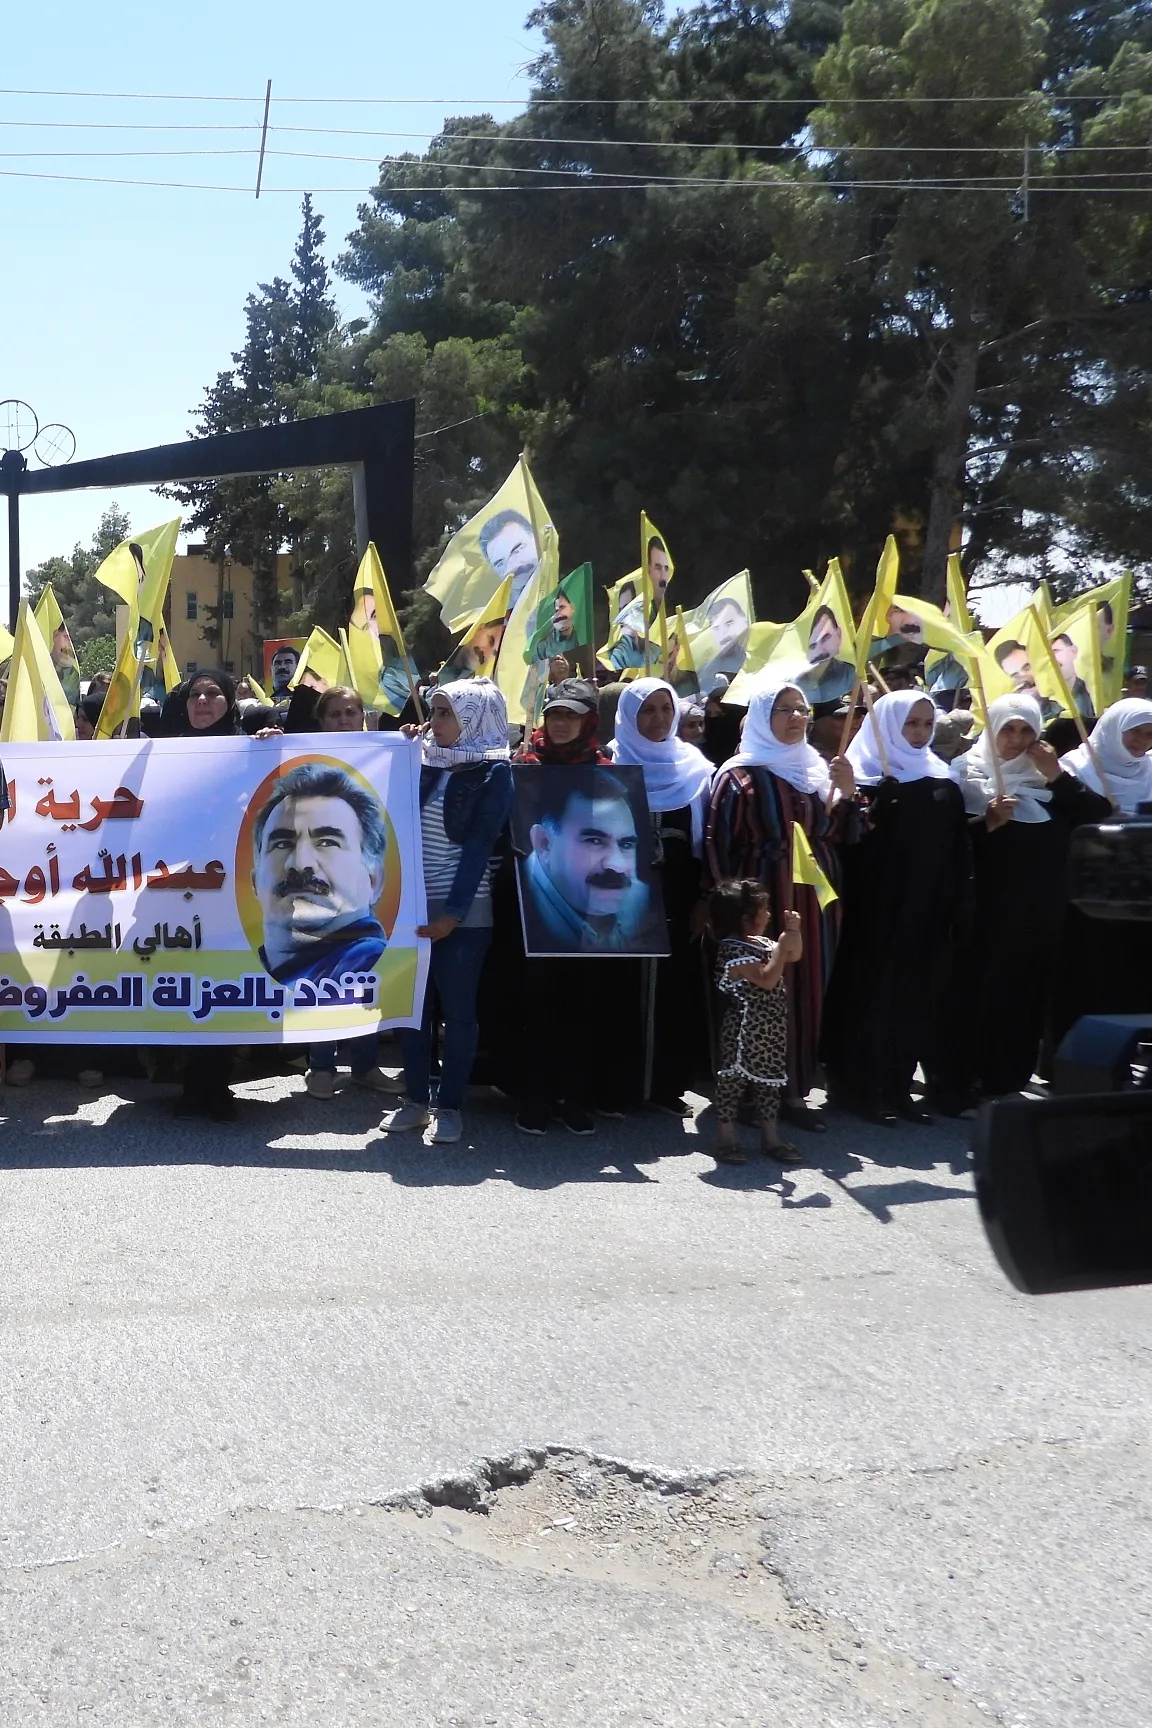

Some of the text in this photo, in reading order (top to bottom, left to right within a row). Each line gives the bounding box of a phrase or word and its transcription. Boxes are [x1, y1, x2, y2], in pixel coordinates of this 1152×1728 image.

[35, 777, 145, 832] حرية
[32, 914, 203, 962] أهالي الطبقة
[152, 976, 284, 1019] بالعزلة
[294, 975, 377, 1007] تندد
